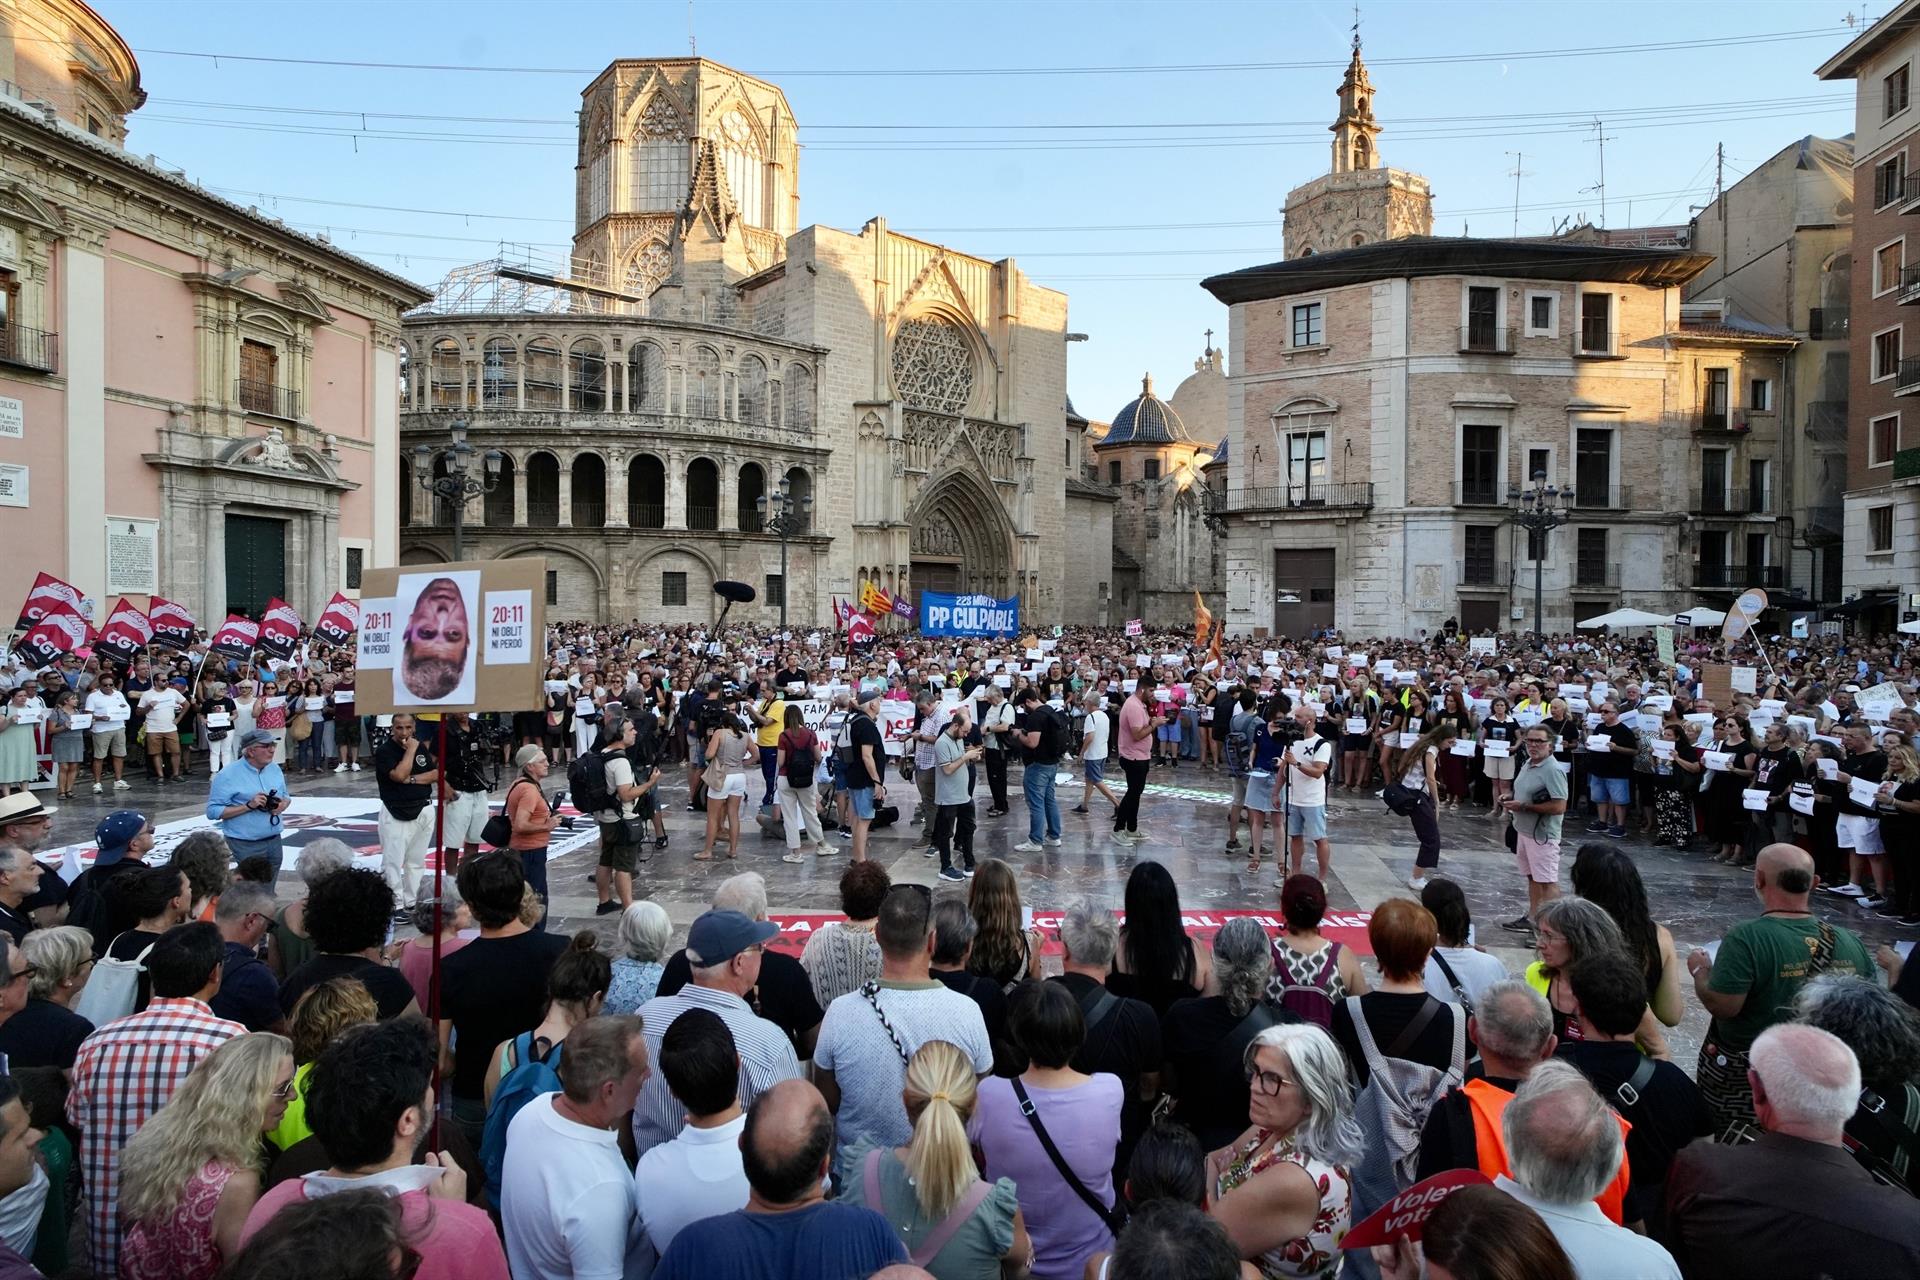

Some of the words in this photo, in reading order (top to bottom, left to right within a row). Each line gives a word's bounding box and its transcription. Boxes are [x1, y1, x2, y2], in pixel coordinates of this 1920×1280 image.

[956, 595, 972, 607] 228
[973, 594, 997, 608] MORTS
[365, 612, 391, 631] 20:11
[493, 605, 523, 624] 20:11
[928, 606, 950, 629] PP
[952, 607, 1014, 631] CULPABLE
[156, 623, 189, 639] CGT
[265, 627, 295, 648] CGT
[321, 620, 348, 640] CGT
[363, 634, 370, 643] NI
[372, 632, 391, 643] OBLIT
[492, 628, 499, 637] NI
[501, 626, 523, 637] OBLIT
[32, 633, 63, 660] CGT
[107, 631, 141, 653] CGT
[363, 645, 370, 655] NI
[492, 640, 499, 649] NI
